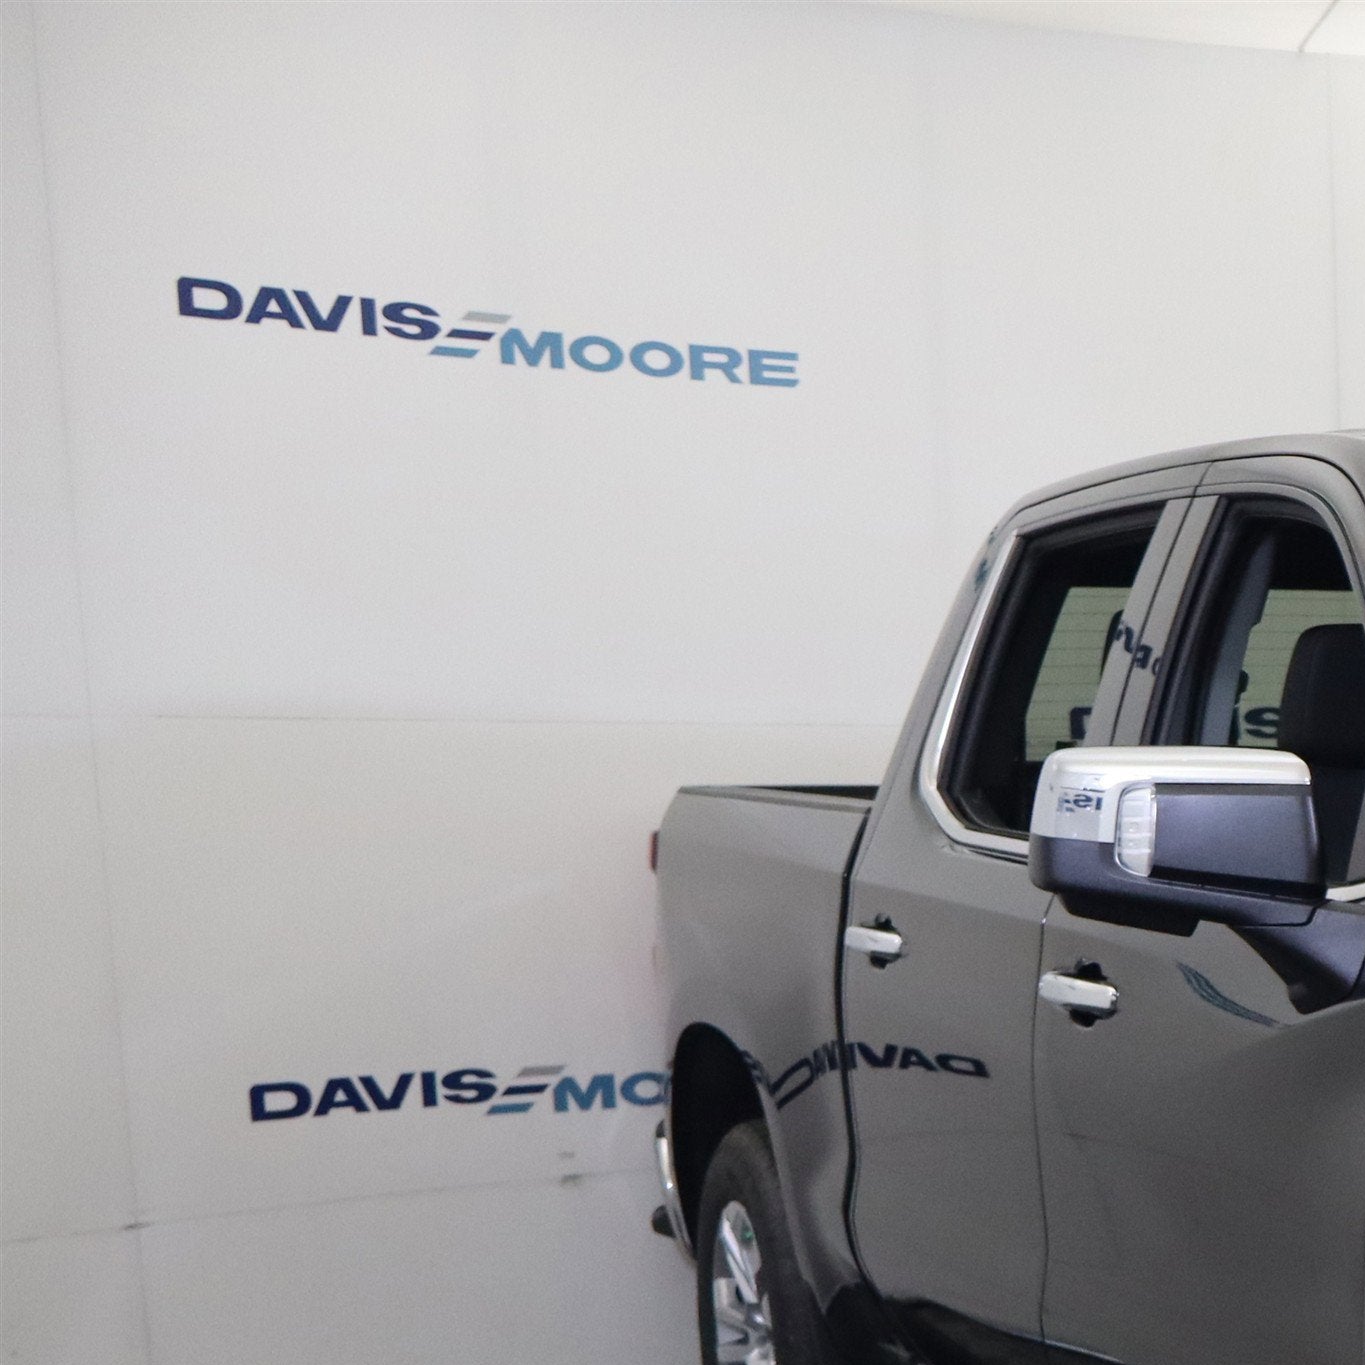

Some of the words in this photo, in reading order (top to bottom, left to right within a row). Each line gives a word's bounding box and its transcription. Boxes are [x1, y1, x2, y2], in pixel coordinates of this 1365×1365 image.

[176, 276, 441, 341] DAVIS
[499, 327, 799, 387] MOORE
[248, 1068, 498, 1122] DAVIS
